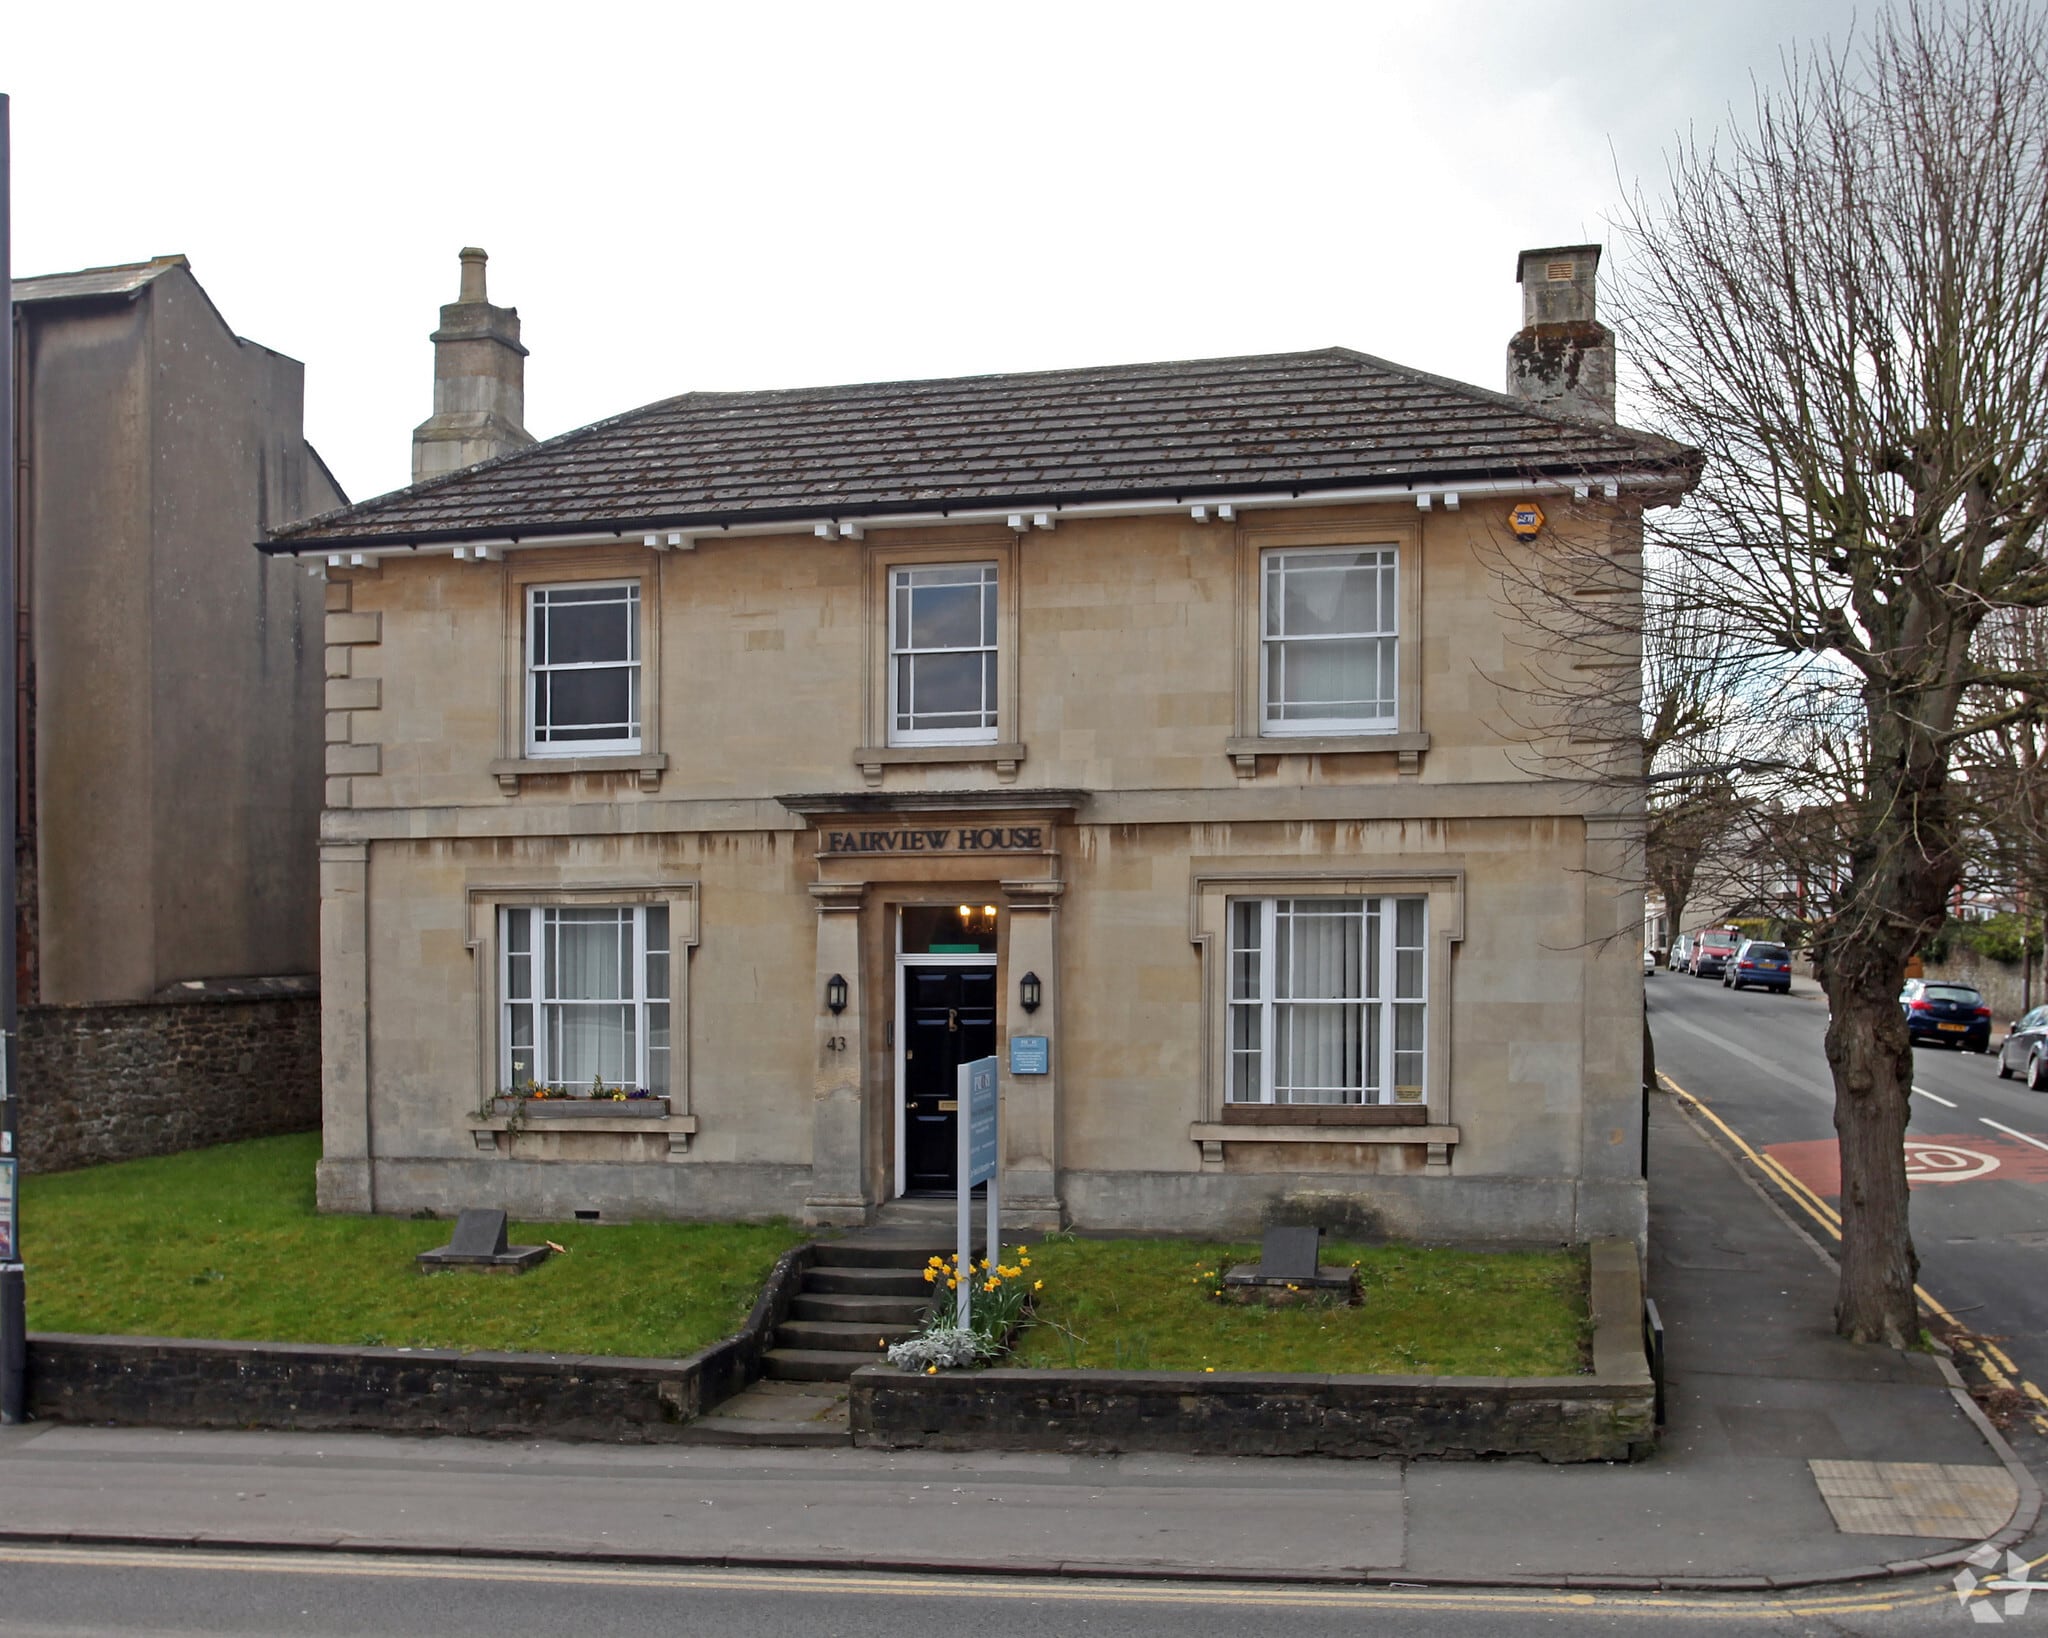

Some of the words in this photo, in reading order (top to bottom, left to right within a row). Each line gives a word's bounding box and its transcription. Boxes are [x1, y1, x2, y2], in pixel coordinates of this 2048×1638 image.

[829, 830, 949, 851] FAIRVIEW
[958, 828, 1041, 850] HOUSE
[826, 1035, 846, 1052] 43
